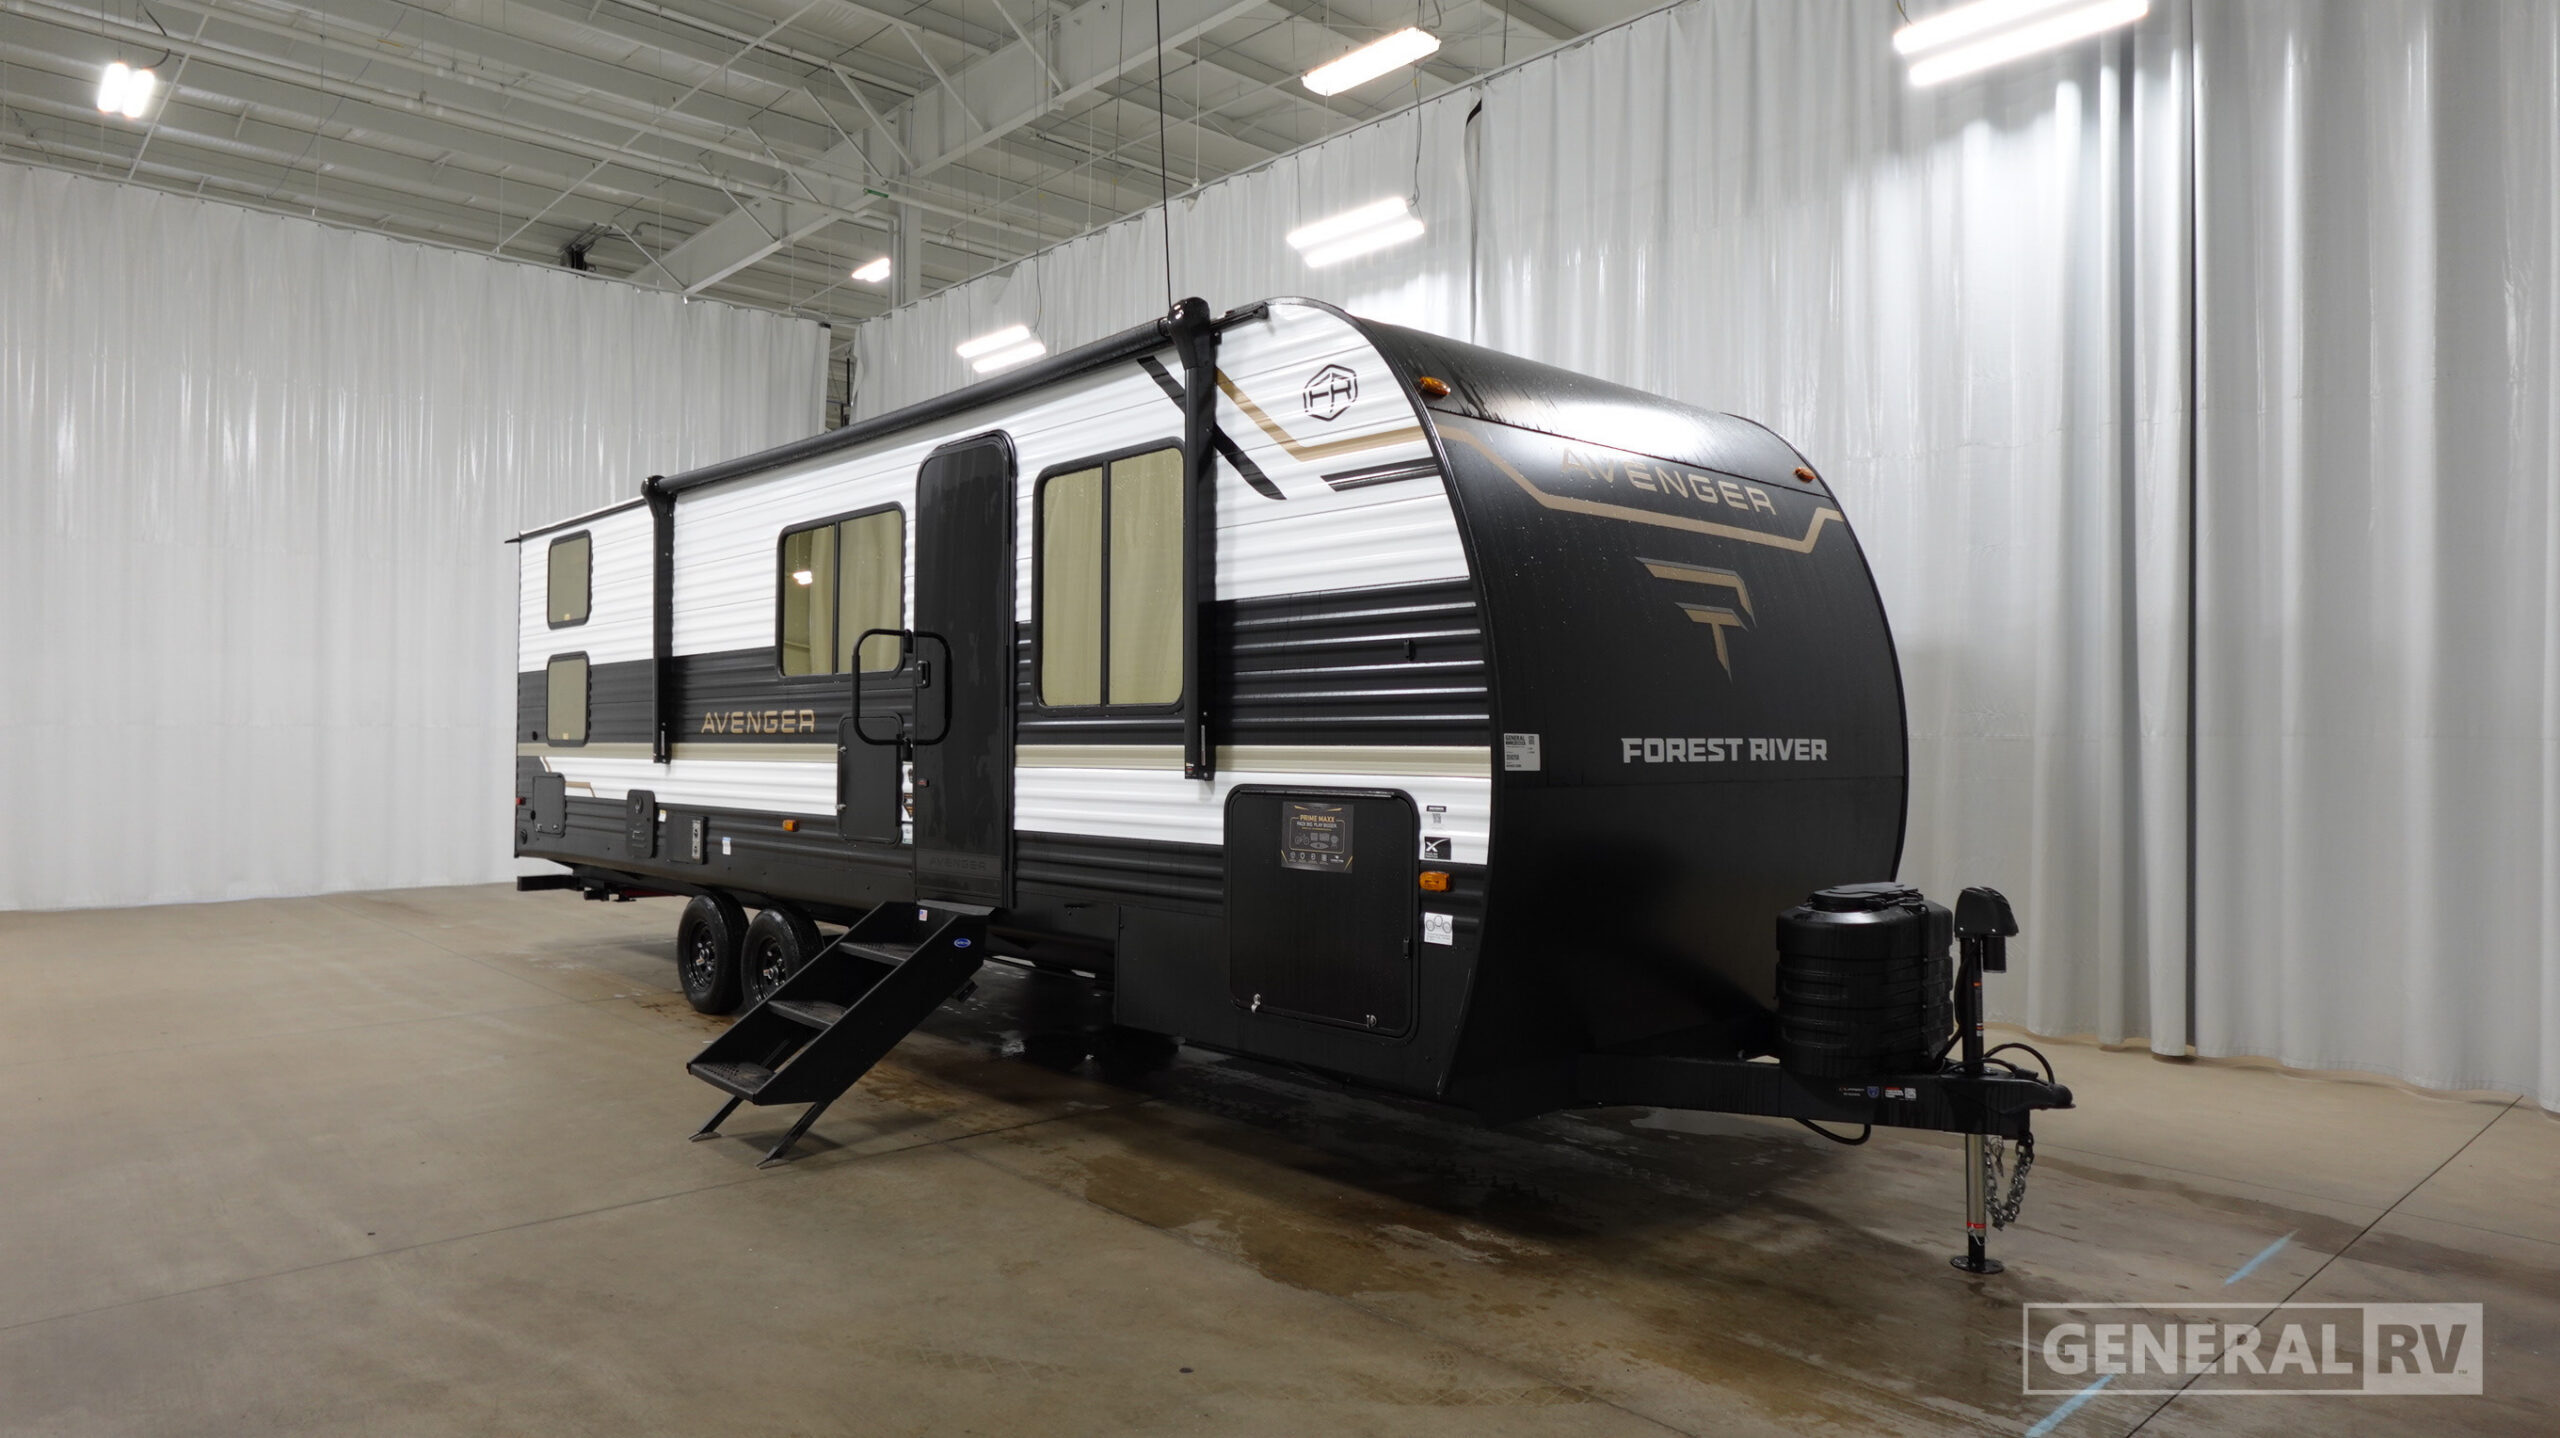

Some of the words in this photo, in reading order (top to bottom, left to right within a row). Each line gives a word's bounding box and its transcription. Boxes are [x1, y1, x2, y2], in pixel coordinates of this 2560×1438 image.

[1561, 446, 1777, 516] AVENGER
[700, 709, 815, 734] AVENGER
[1621, 738, 1743, 763] FOREST
[1749, 738, 1828, 761] RIVER
[929, 856, 986, 871] AVENGER
